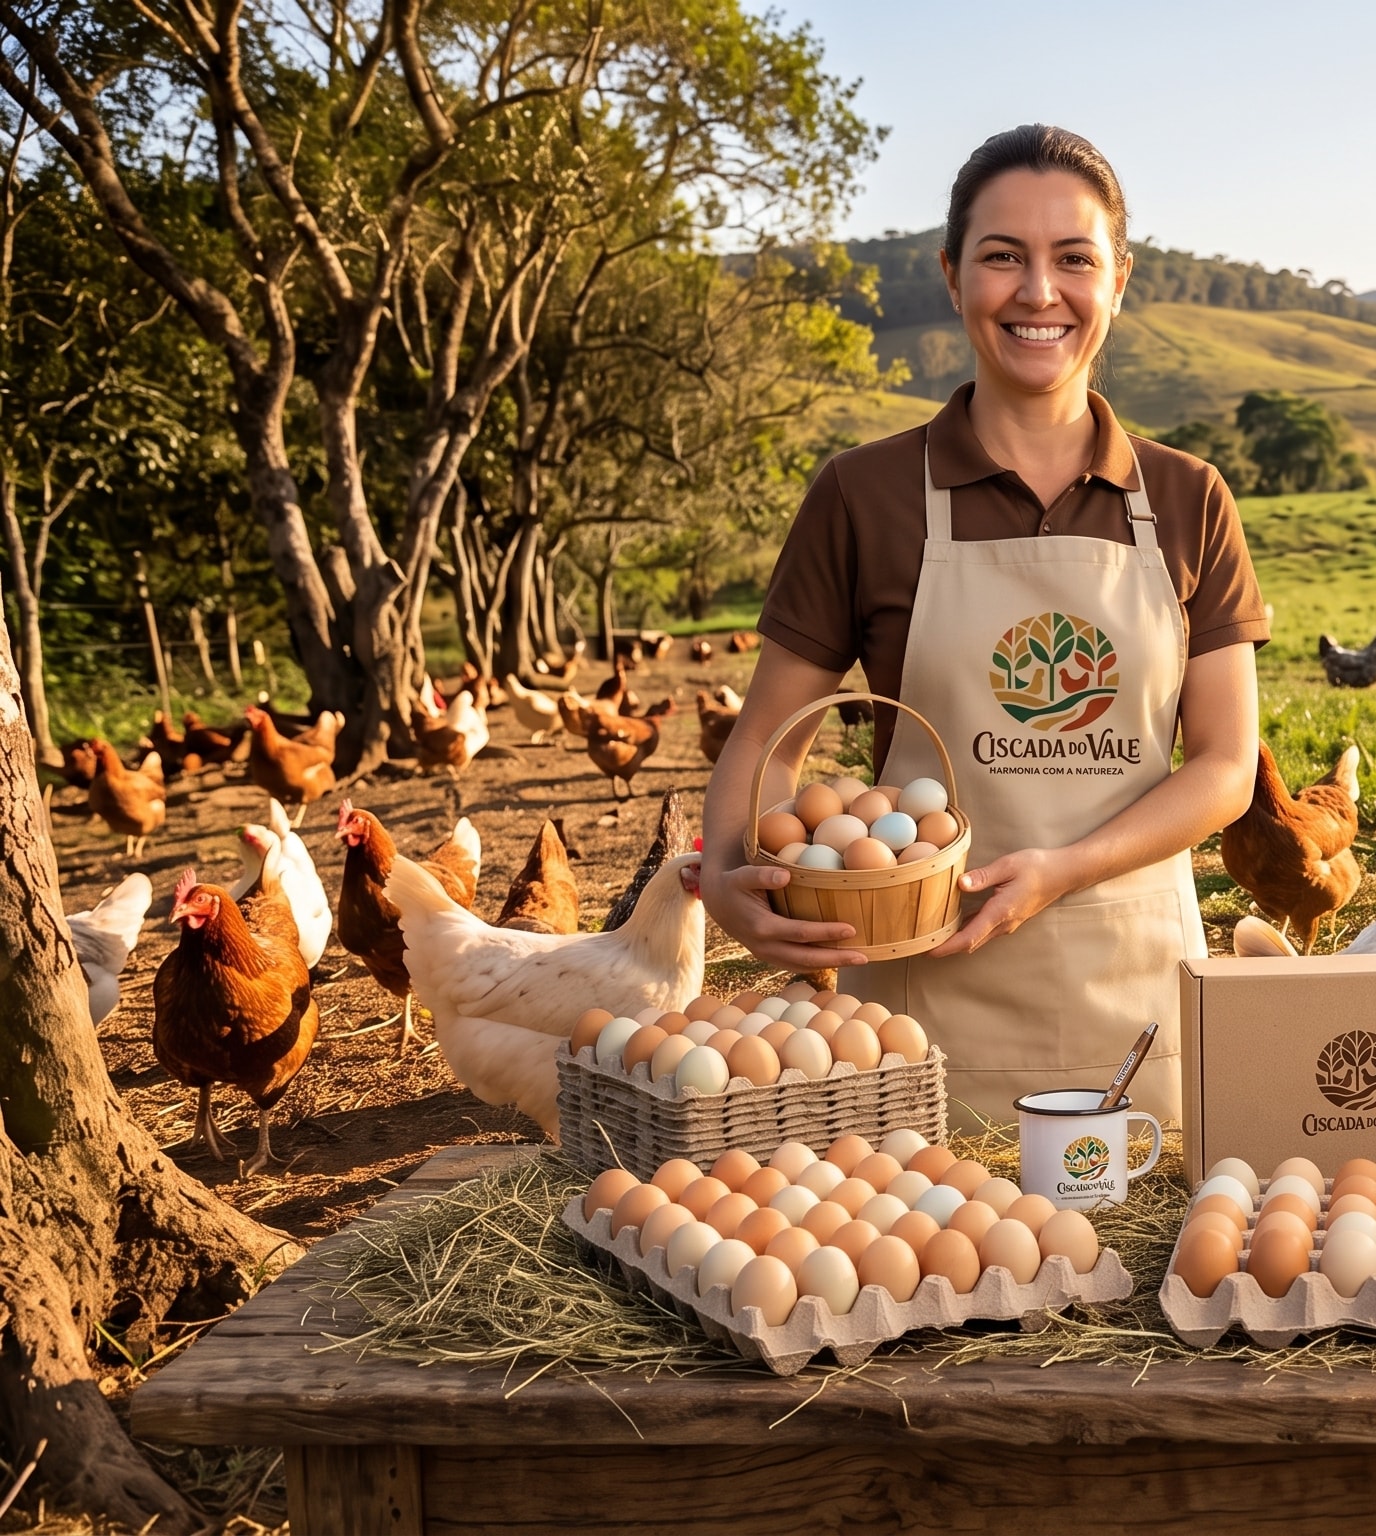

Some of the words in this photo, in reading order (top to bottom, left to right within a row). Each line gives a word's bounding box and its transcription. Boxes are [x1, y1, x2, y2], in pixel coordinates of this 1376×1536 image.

[972, 731, 1067, 765] CISCADA
[1068, 741, 1087, 756] DO
[1085, 728, 1142, 765] VALE
[989, 766, 1041, 776] HARMONIA
[1042, 767, 1065, 776] COM
[1066, 767, 1074, 776] A
[1075, 767, 1125, 776] NATUREZA
[1301, 1113, 1366, 1137] CISCADA
